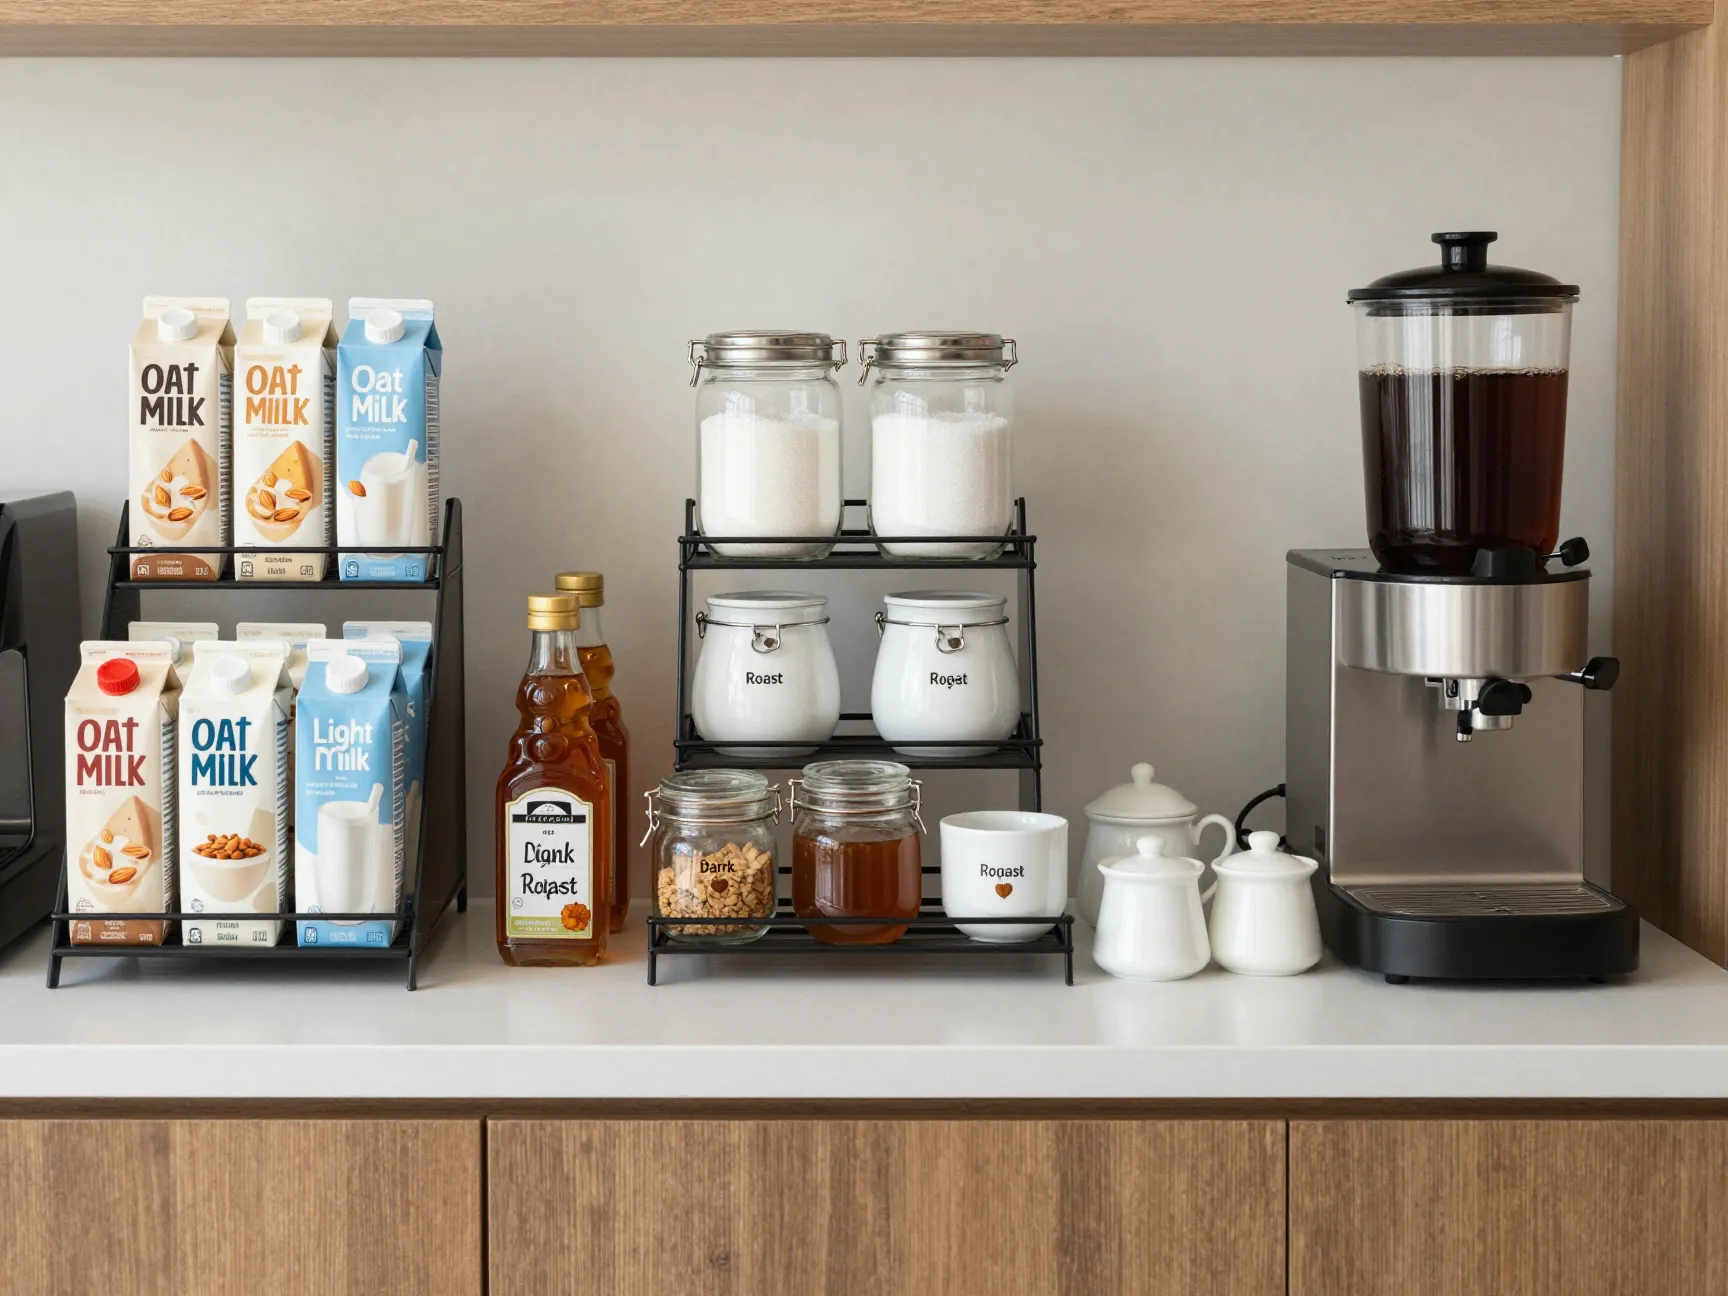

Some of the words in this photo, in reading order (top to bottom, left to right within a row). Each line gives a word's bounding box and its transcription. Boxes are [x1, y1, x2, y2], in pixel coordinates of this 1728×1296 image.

[351, 364, 403, 394] Oat
[140, 395, 206, 426] MILK
[745, 671, 784, 685] Roast
[313, 717, 373, 751] Light
[77, 753, 147, 787] MILK
